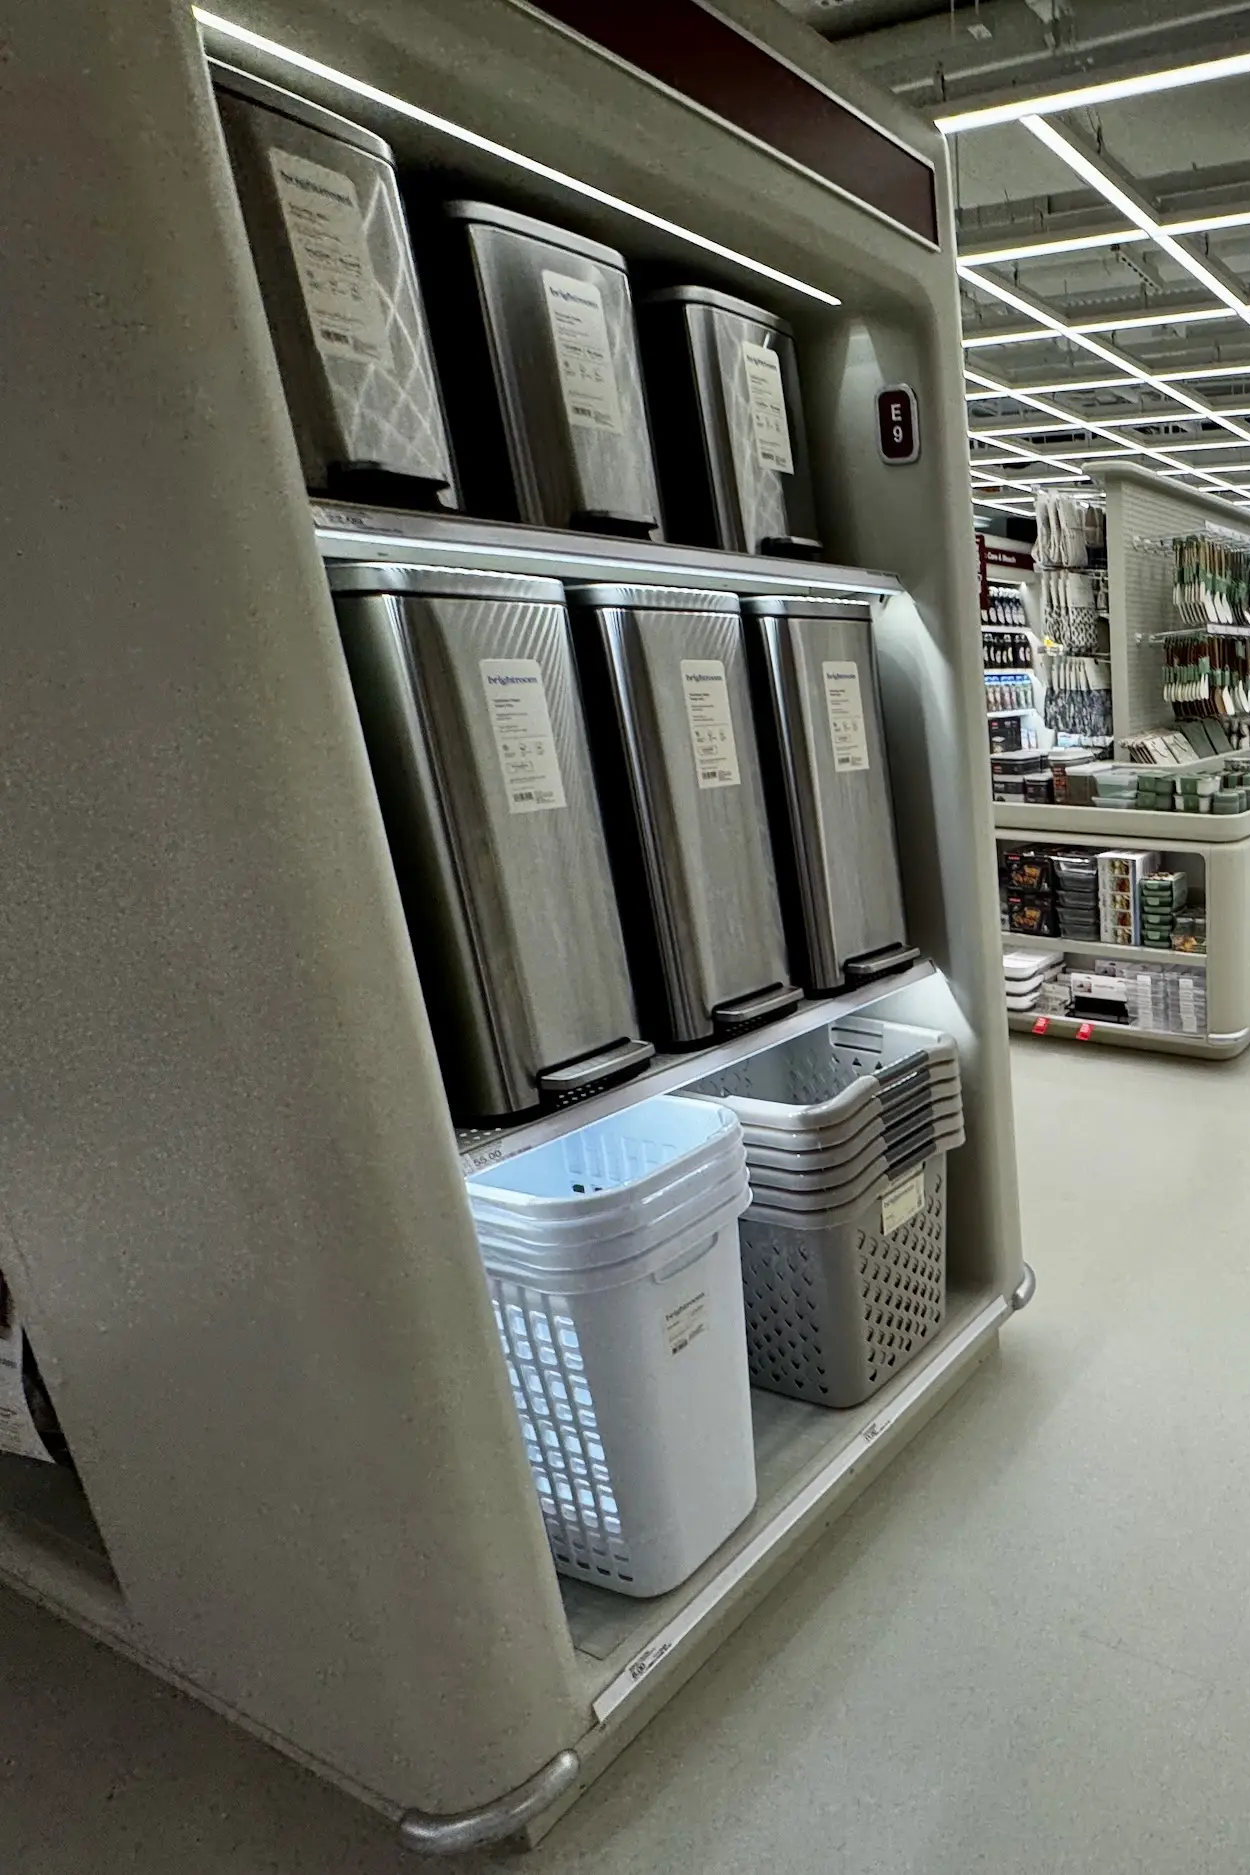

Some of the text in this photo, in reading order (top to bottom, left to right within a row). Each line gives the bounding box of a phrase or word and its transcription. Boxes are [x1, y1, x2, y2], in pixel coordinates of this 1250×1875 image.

[890, 403, 902, 422] E
[892, 425, 903, 443] 9
[487, 675, 539, 687] brightroom
[685, 673, 723, 683] brightroom
[473, 1149, 502, 1166] 55.00
[665, 1291, 706, 1321] brightroom
